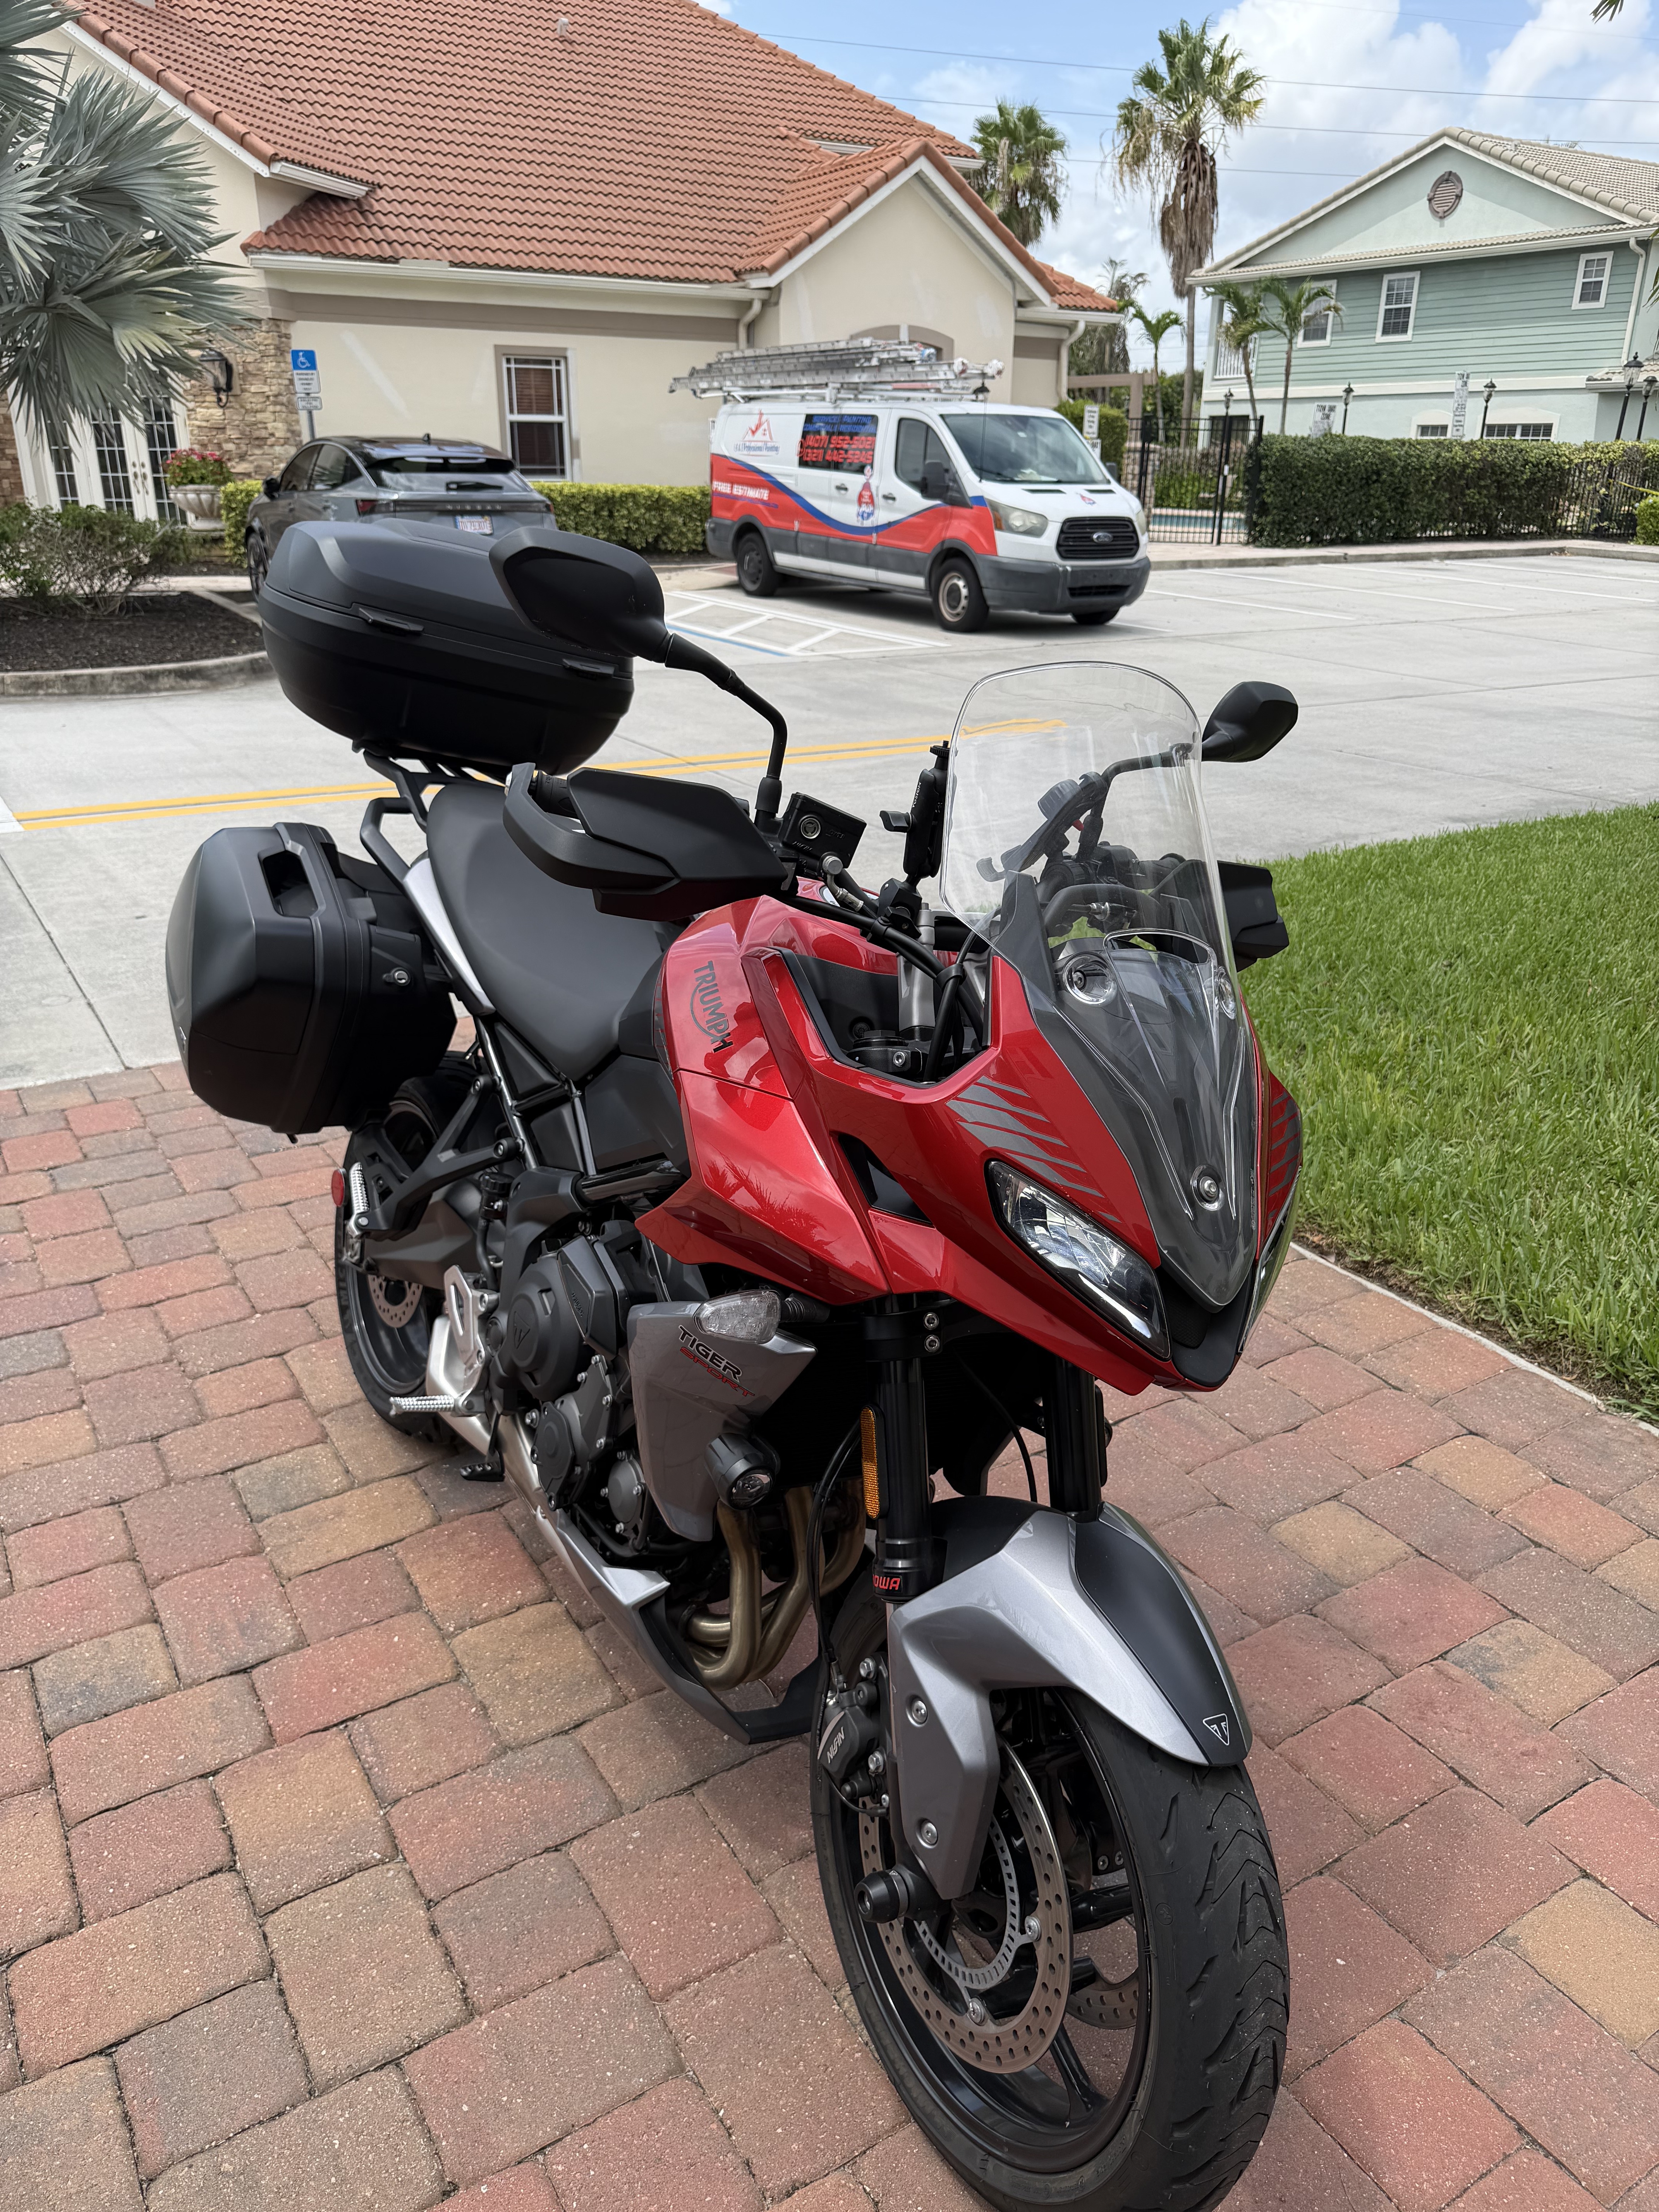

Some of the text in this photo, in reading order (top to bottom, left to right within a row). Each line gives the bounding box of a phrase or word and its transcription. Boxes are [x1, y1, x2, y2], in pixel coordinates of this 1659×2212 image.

[732, 483, 770, 500] ESTIMATE
[690, 960, 734, 1053] TRIUMPH
[678, 1324, 742, 1383] TIGER
[680, 1346, 755, 1397] SPORT
[872, 1574, 900, 1590] OWA
